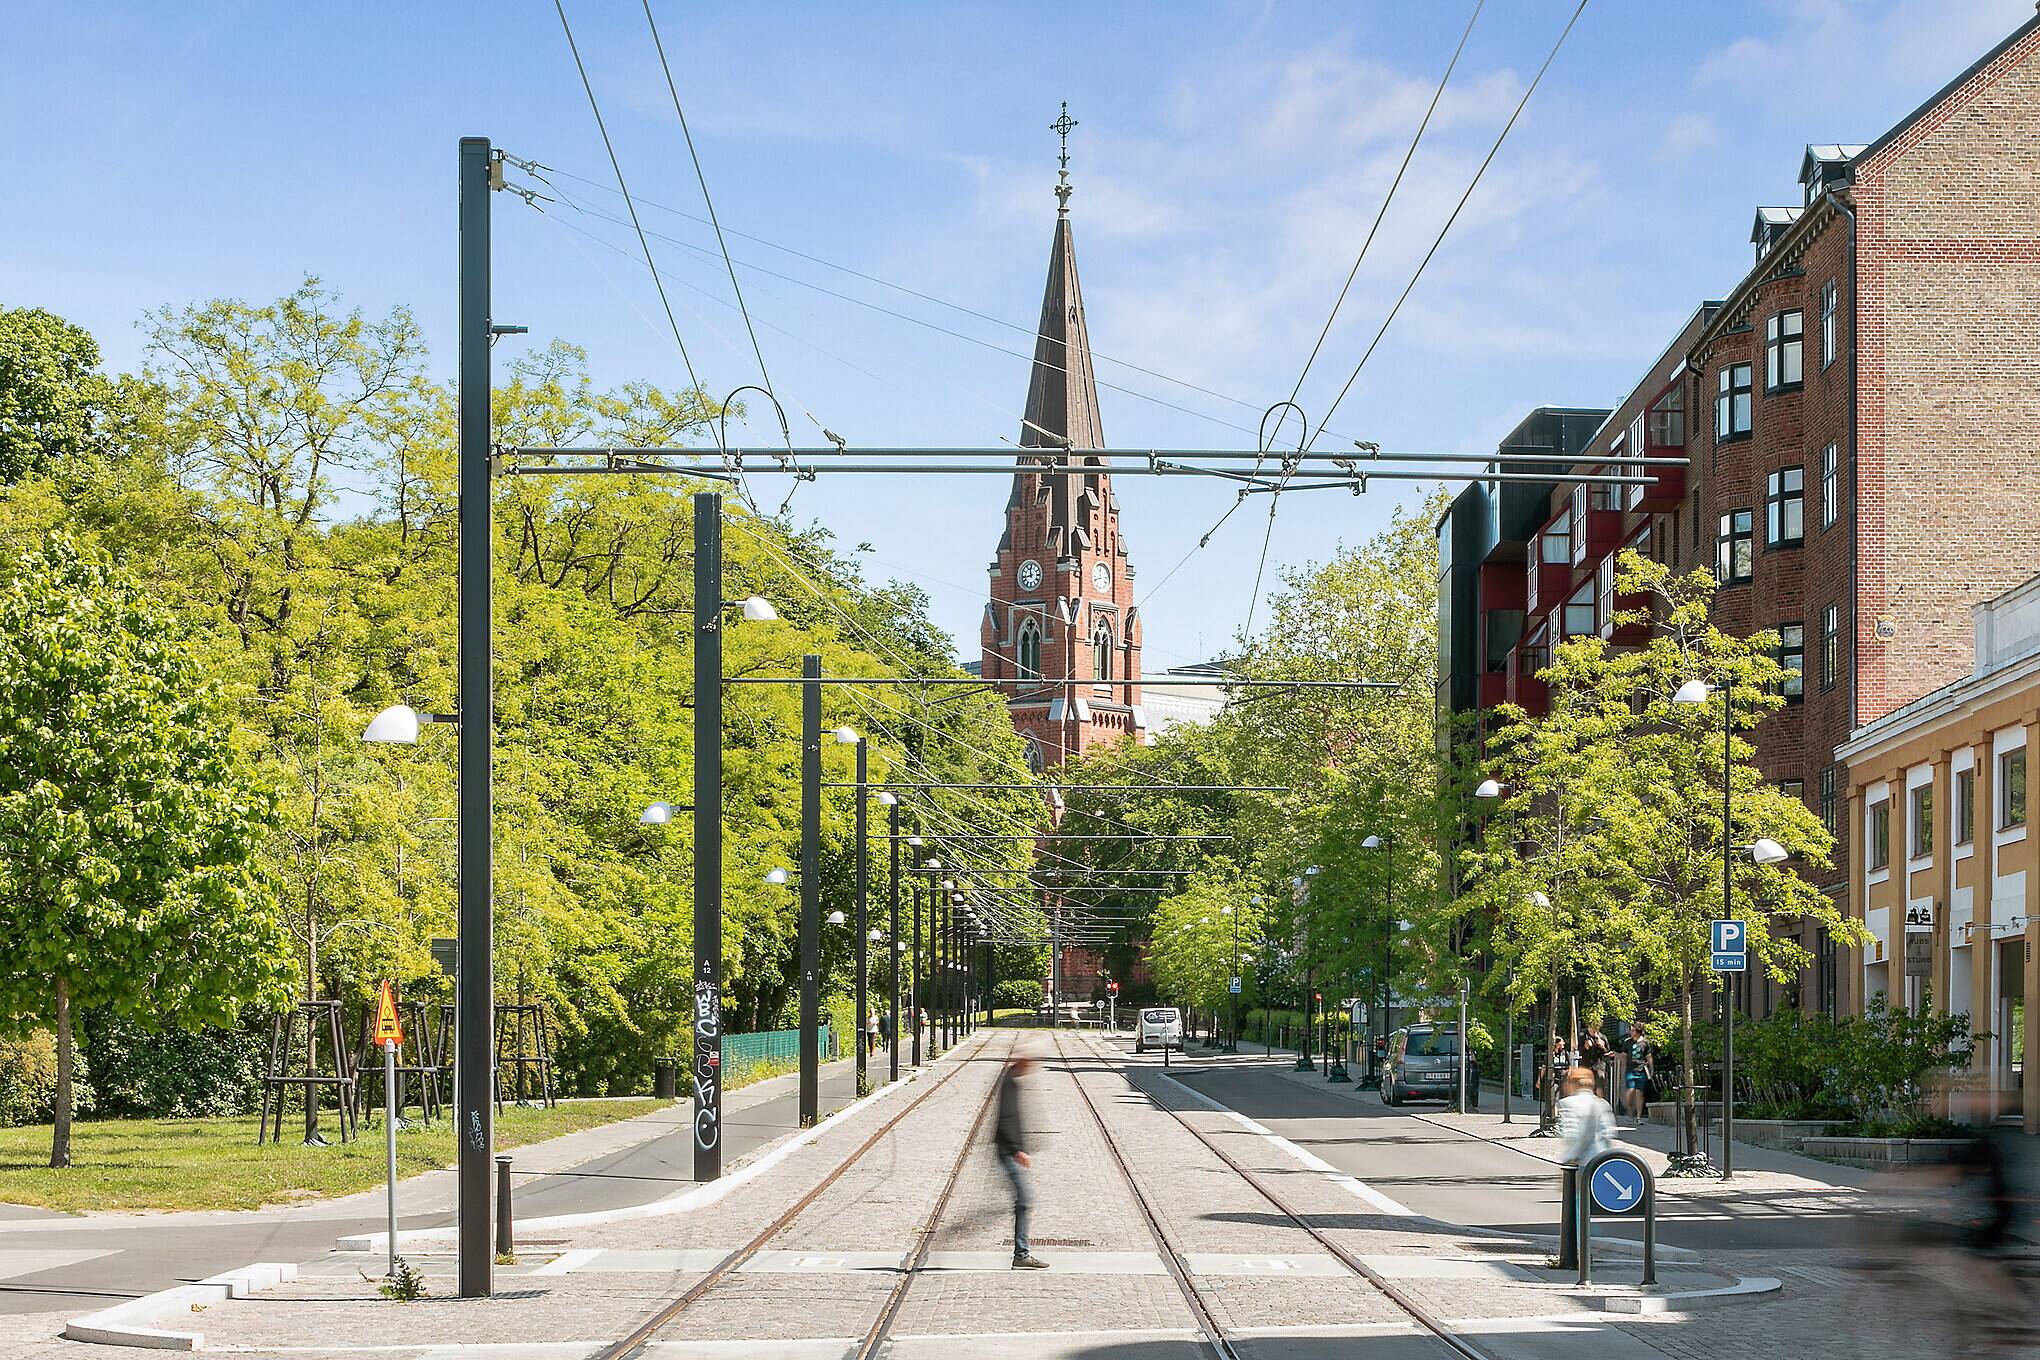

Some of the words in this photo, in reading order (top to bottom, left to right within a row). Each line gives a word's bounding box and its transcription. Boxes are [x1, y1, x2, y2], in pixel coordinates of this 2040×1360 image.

[1721, 924, 1740, 950] P
[1727, 958, 1741, 966] min
[1233, 978, 1240, 986] P
